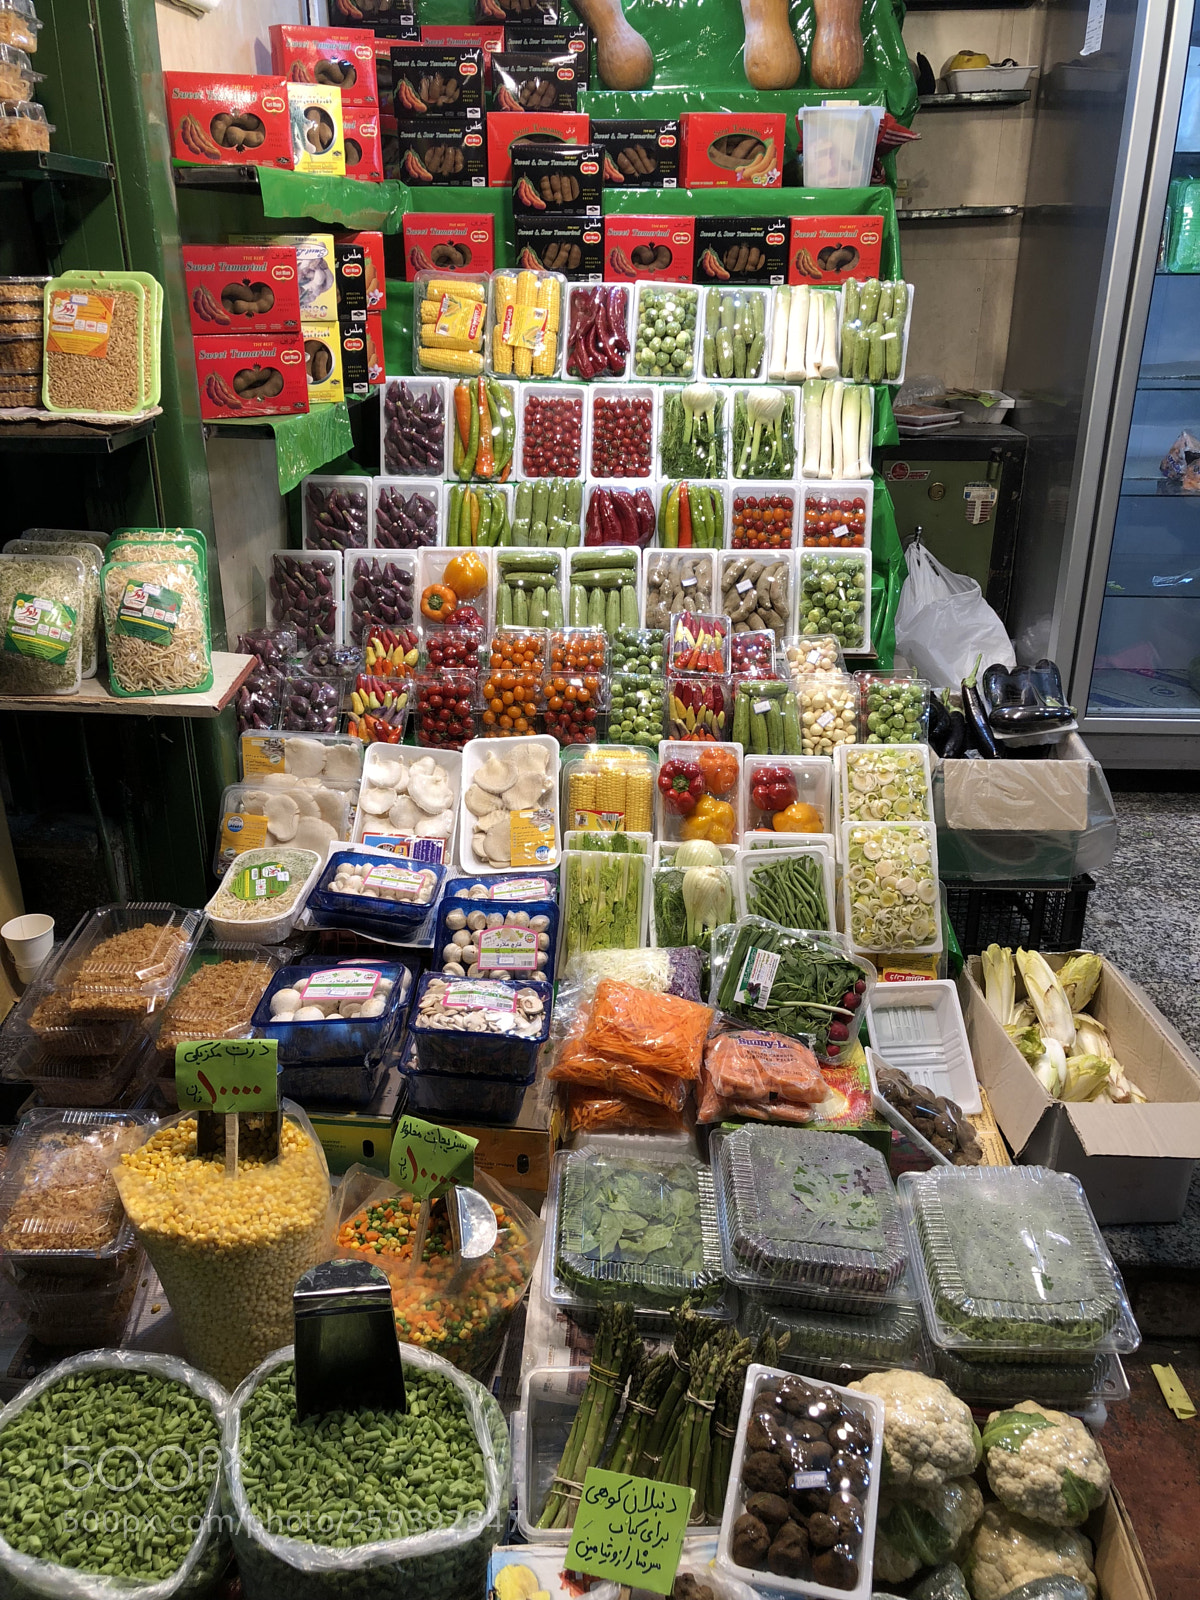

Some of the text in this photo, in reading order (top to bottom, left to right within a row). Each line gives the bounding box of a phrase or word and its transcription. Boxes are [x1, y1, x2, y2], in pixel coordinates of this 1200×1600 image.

[594, 132, 610, 140] Sweet
[616, 132, 629, 140] Sour
[630, 132, 656, 140] Tamarind
[582, 148, 600, 160] ملس
[584, 218, 602, 230] ملس
[768, 220, 786, 231] ملس
[406, 228, 428, 236] Sweet
[430, 228, 468, 236] Tamarind
[518, 228, 535, 236] Sweet
[540, 228, 553, 236] Sour
[607, 228, 670, 237] Sweet Tamarind
[700, 230, 716, 238] Sweet
[724, 230, 736, 238] Sour
[737, 230, 764, 238] Tamarind
[794, 230, 816, 238] Sweet
[818, 230, 858, 238] Tamarind
[342, 249, 362, 262] ملس
[184, 261, 268, 272] Sweet Tamarind
[344, 324, 363, 336] ملس
[198, 350, 227, 360] Sweet
[230, 348, 277, 358] Tamarind
[184, 1042, 222, 1065] مکزیکی
[400, 1120, 422, 1139] مخلوط
[585, 1480, 677, 1517] دنبلان کوهی
[608, 1516, 670, 1548] برای کباب
[576, 1537, 622, 1564] ویتامین
[626, 1549, 662, 1574] سرشار
